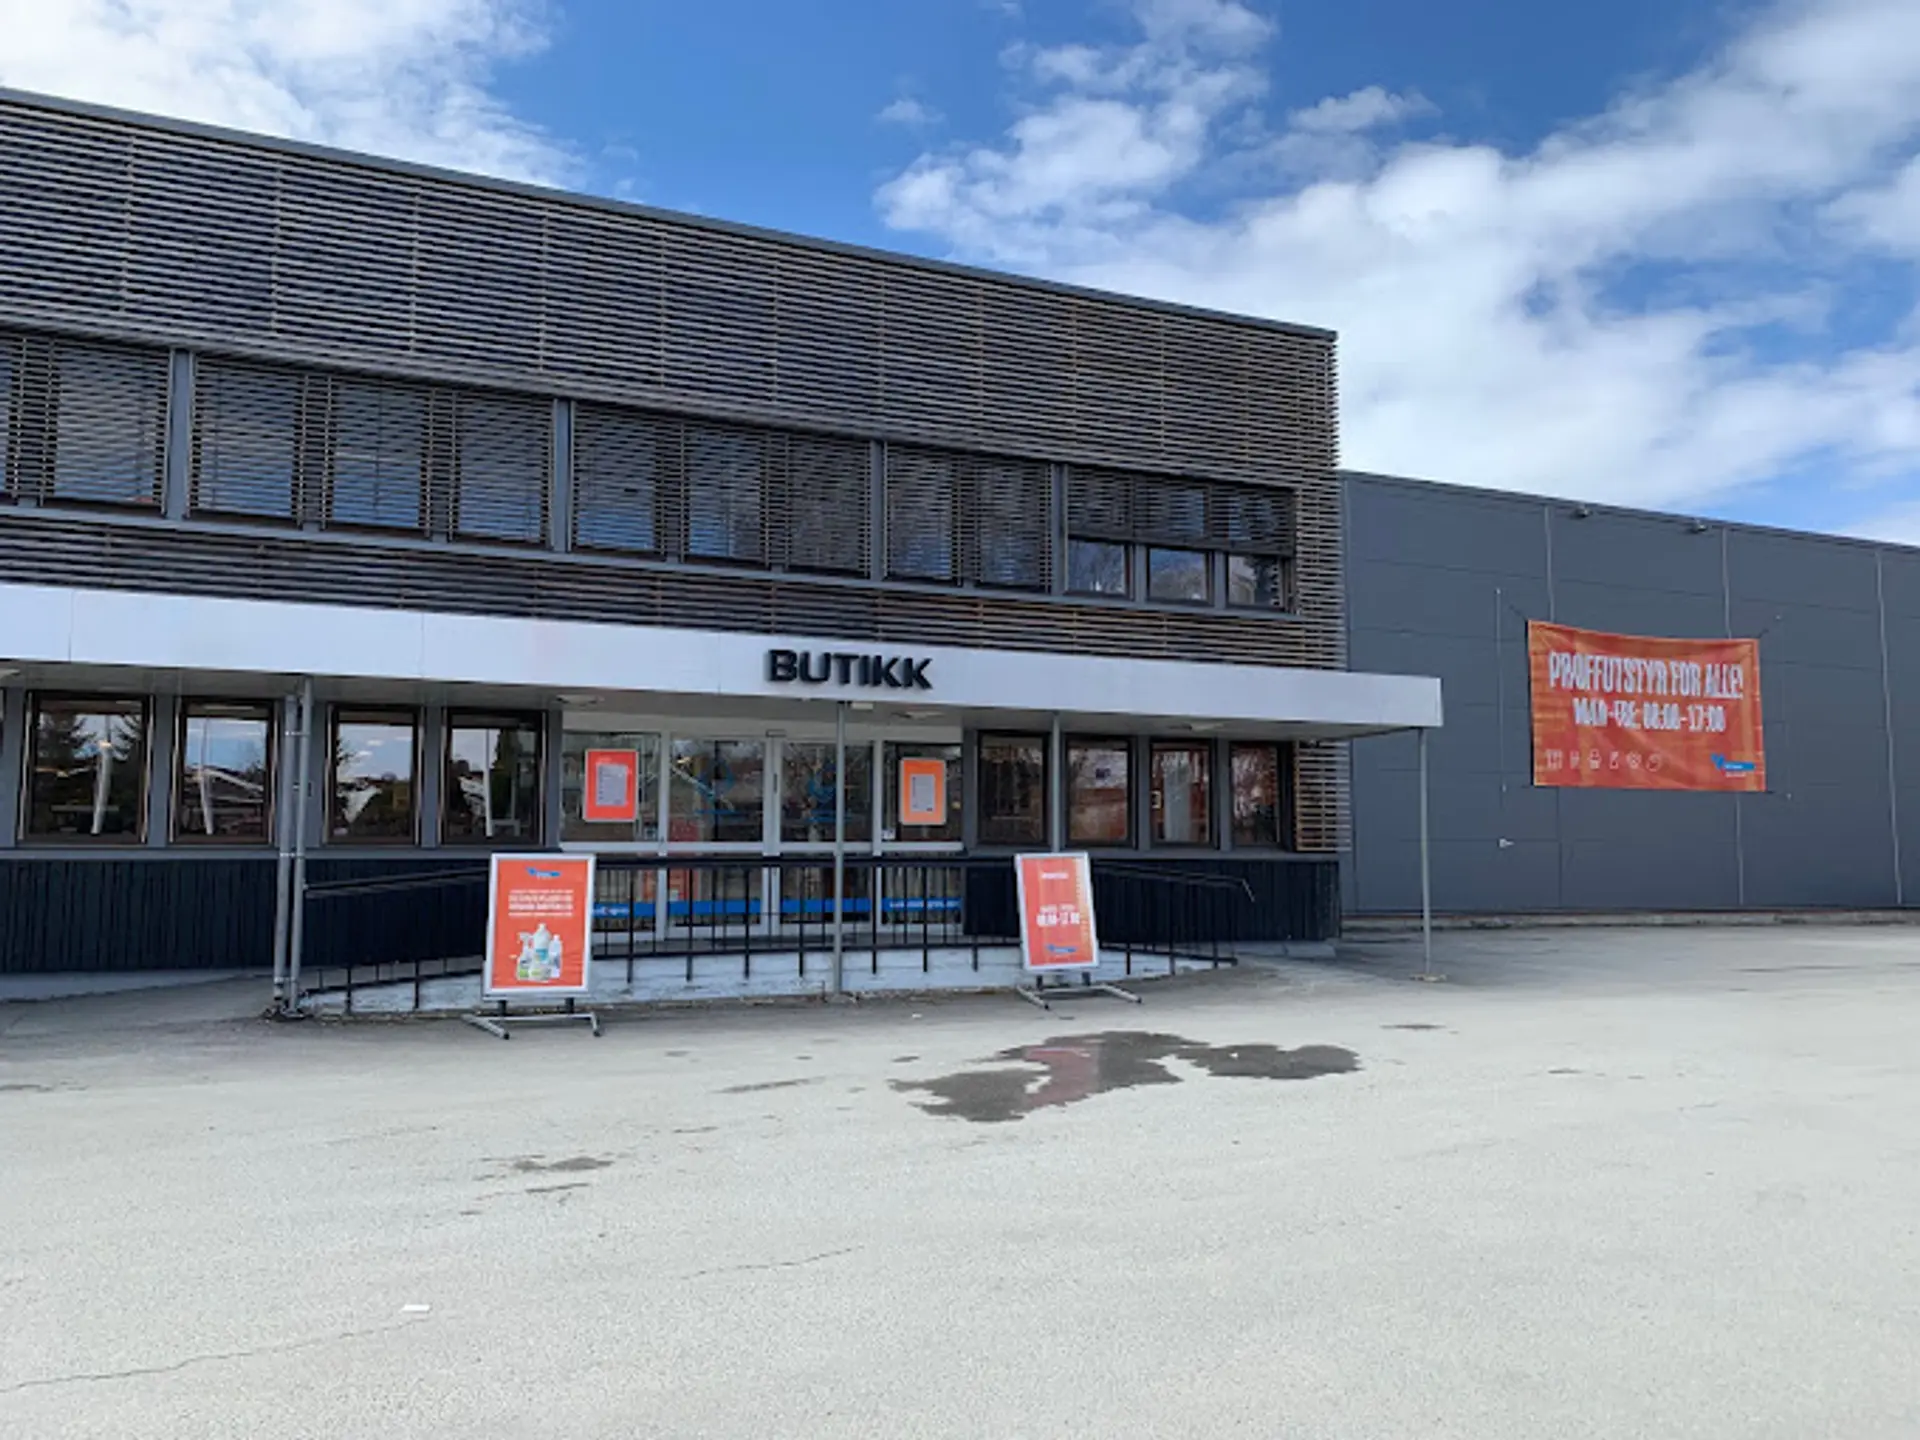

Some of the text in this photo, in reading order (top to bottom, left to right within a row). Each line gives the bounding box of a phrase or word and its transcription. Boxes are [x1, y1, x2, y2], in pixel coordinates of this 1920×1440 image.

[766, 649, 933, 689] BUTIKK
[1549, 651, 1667, 696] PROFFUTSTYR
[1670, 660, 1701, 696] FOR
